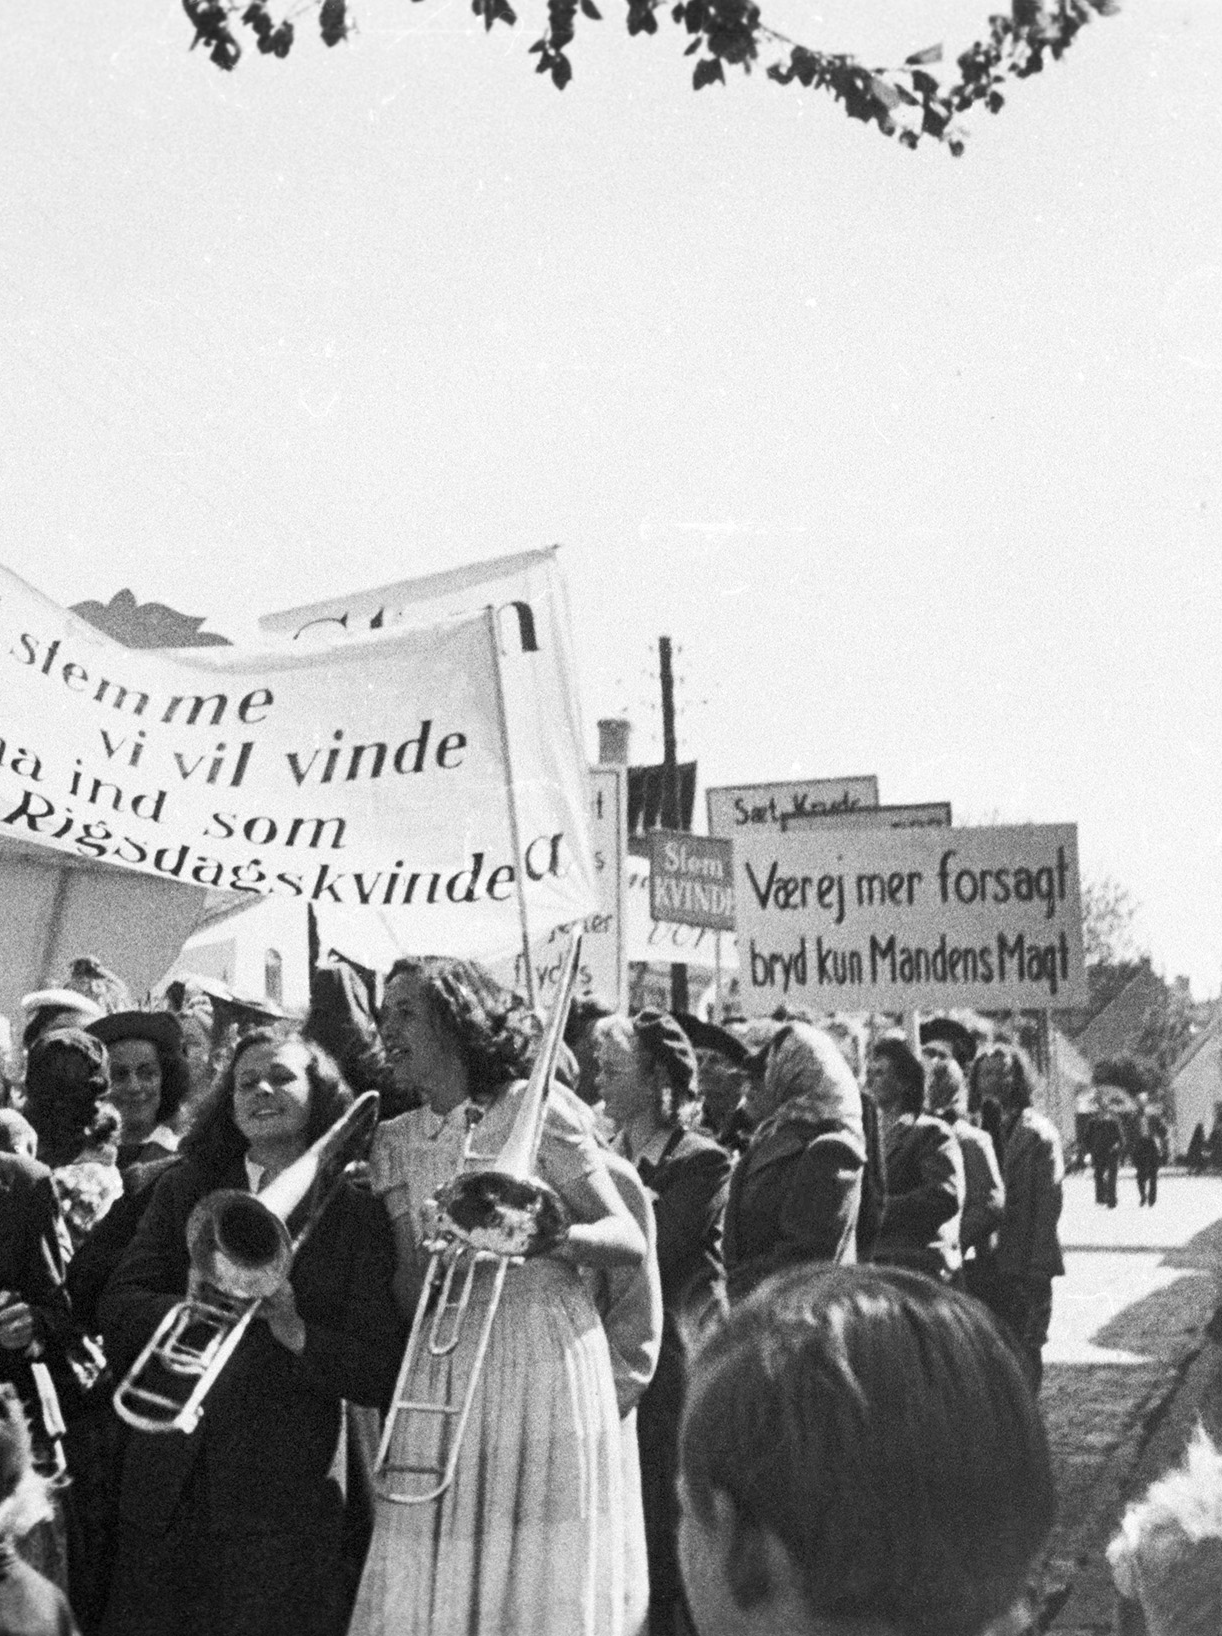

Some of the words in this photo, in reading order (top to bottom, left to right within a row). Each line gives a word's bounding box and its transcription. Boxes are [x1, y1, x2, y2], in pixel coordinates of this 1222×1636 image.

[10, 632, 274, 726] stemme
[100, 728, 146, 767] vi
[173, 741, 255, 788] vil
[285, 719, 468, 787] vinde
[68, 758, 168, 823] ind
[203, 811, 347, 849] som
[0, 789, 516, 905] Rigsdagskvinde
[745, 861, 812, 910] Vær
[817, 854, 845, 924] ej
[857, 871, 923, 906] mer
[938, 846, 1069, 920] forsagt
[750, 936, 807, 993] bryd
[816, 935, 863, 986] kun
[870, 933, 994, 984] Mandens
[997, 931, 1069, 995] Magt
